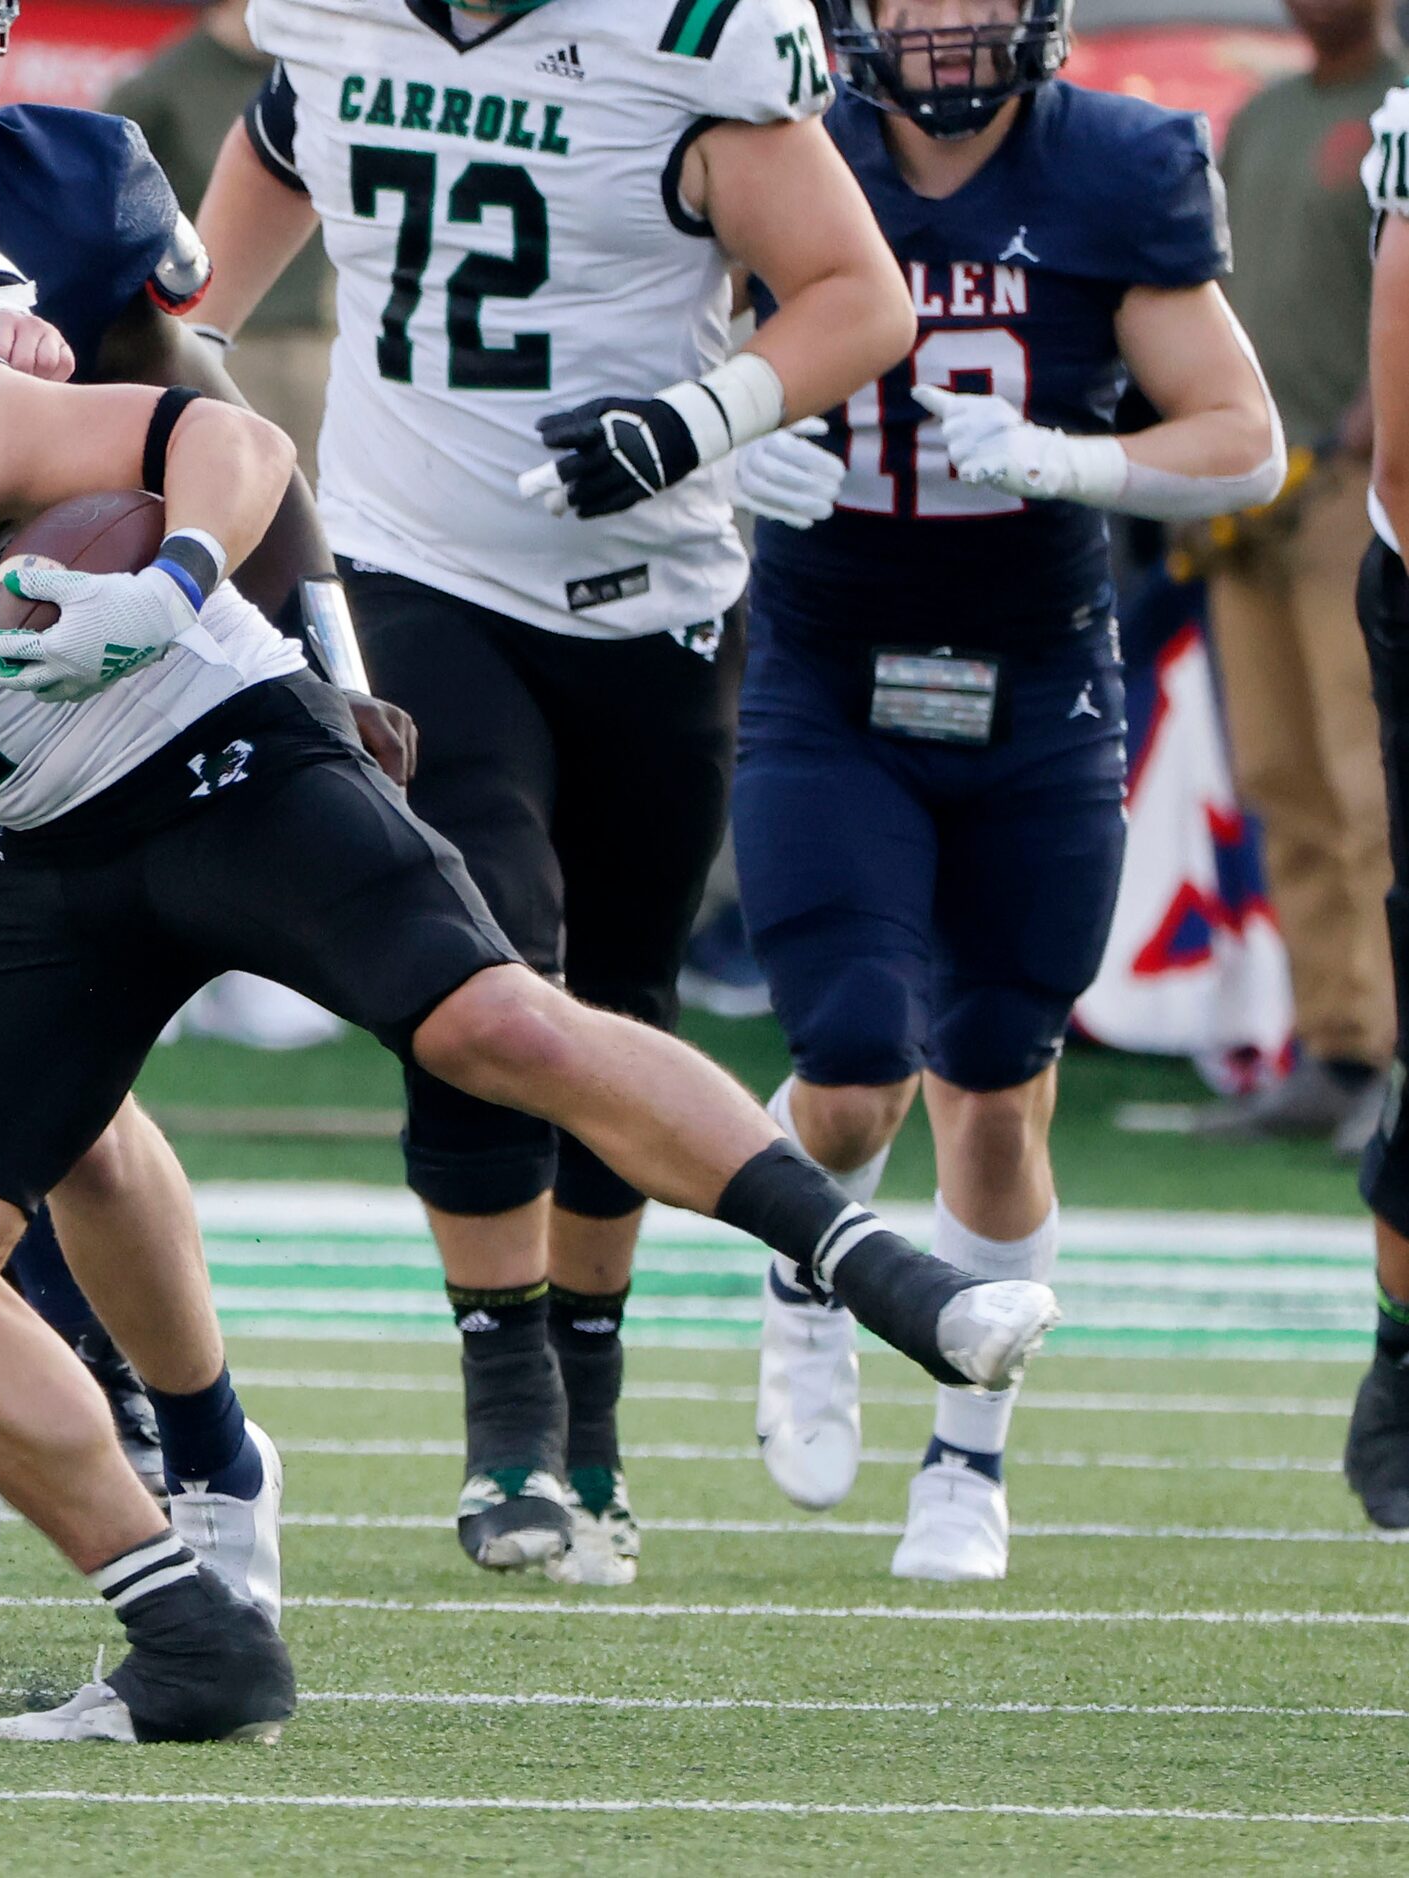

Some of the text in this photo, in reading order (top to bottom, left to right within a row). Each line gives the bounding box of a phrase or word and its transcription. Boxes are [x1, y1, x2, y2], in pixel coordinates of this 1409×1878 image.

[774, 25, 829, 105] 72
[339, 75, 569, 156] CARROLL
[349, 144, 551, 391] 72
[910, 261, 1028, 316] LEN
[835, 327, 1031, 519] 12
